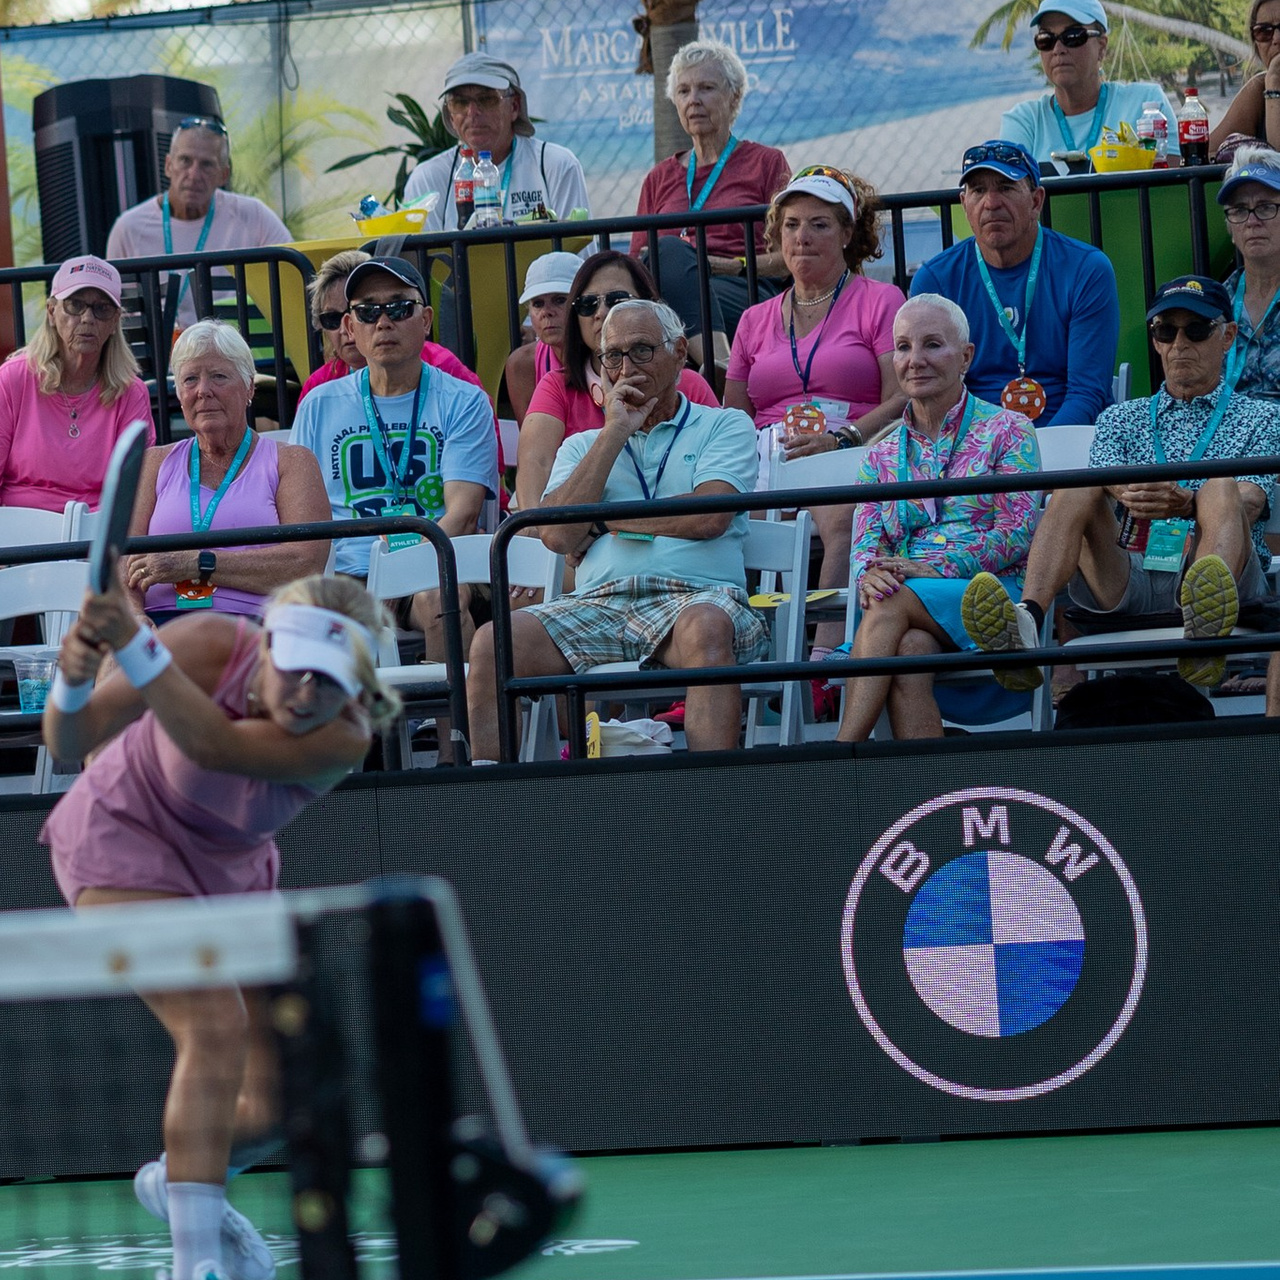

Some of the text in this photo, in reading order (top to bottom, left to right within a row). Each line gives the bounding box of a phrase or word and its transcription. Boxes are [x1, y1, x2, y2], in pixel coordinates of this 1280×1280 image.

[511, 190, 543, 204] ENGAGE
[331, 426, 357, 480] NATIONAL
[390, 539, 419, 548] ATHLETE
[879, 805, 1100, 894] BMW
